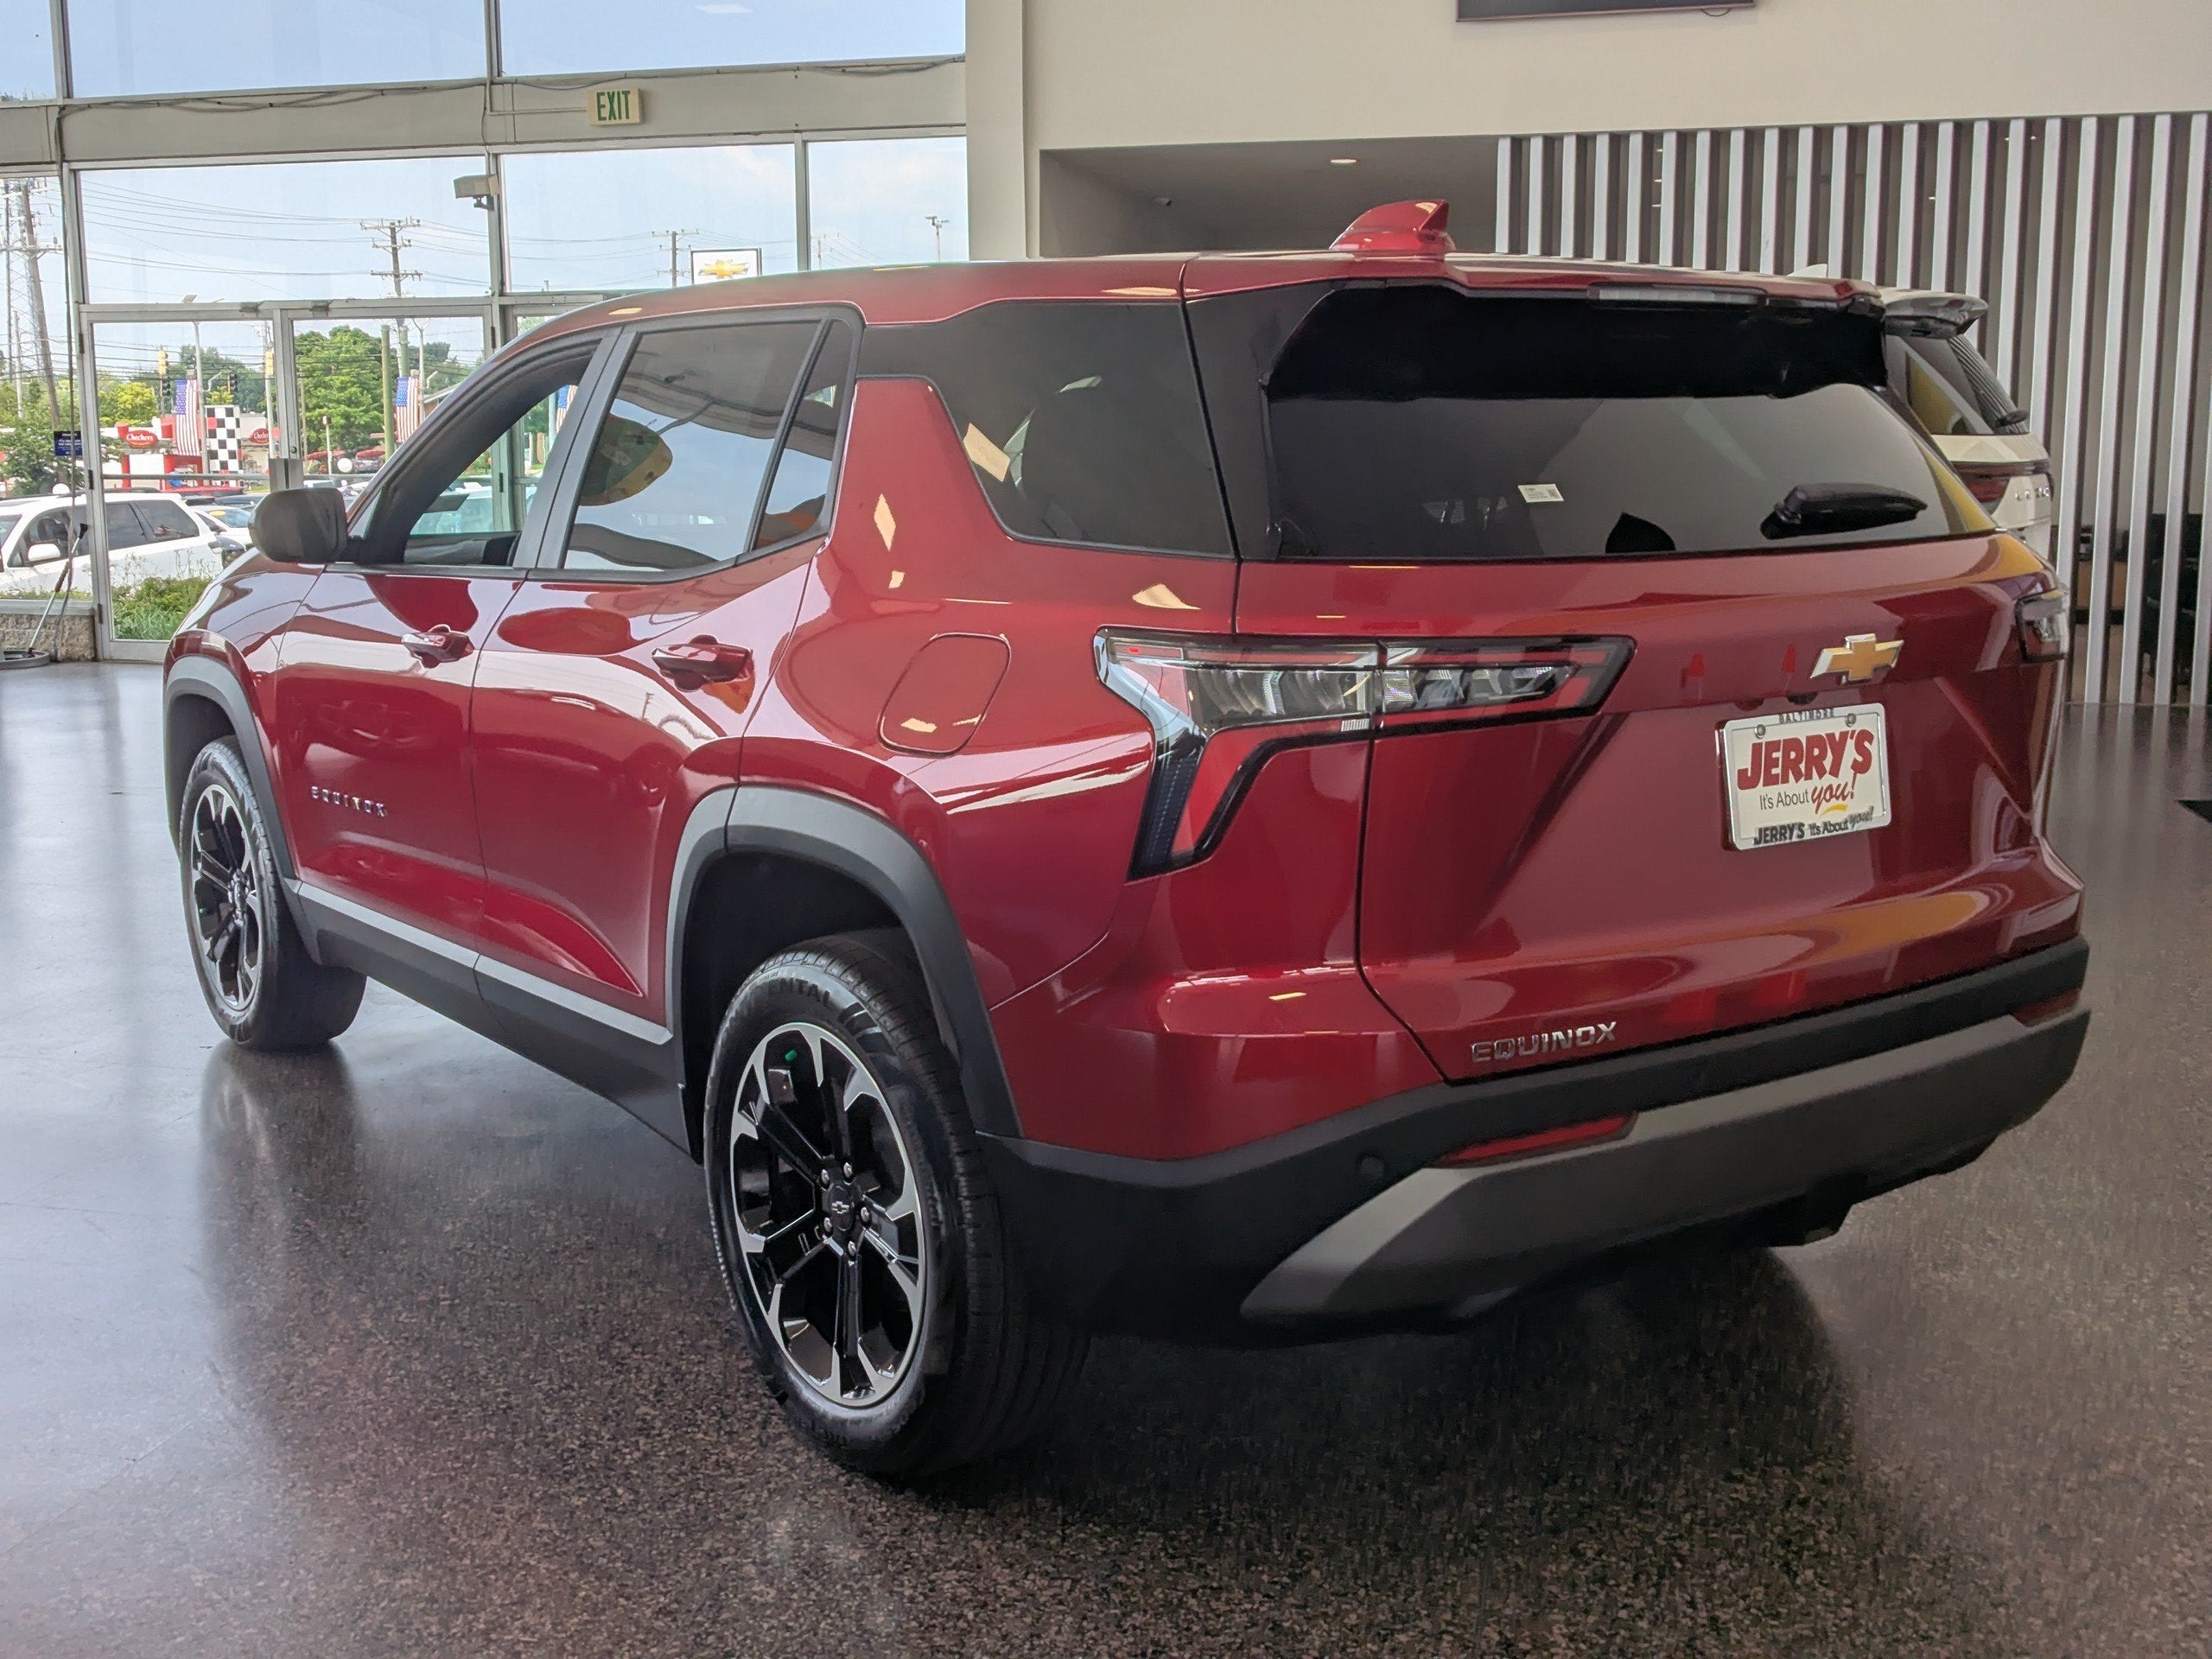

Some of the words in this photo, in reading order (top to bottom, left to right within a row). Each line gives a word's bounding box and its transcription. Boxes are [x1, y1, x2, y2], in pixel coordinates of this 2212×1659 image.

[597, 91, 631, 121] EXIT
[1779, 708, 1834, 724] BALTIMORE
[1737, 729, 1874, 790] JERRY'S
[1759, 792, 1774, 810] It's
[1777, 788, 1809, 807] About
[1811, 772, 1856, 814] you!
[1753, 822, 1806, 845] JERRY'S
[1808, 823, 1821, 836] It's
[1822, 817, 1848, 835] About
[1848, 805, 1874, 829] you!
[1471, 1021, 1617, 1063] EQUINOX
